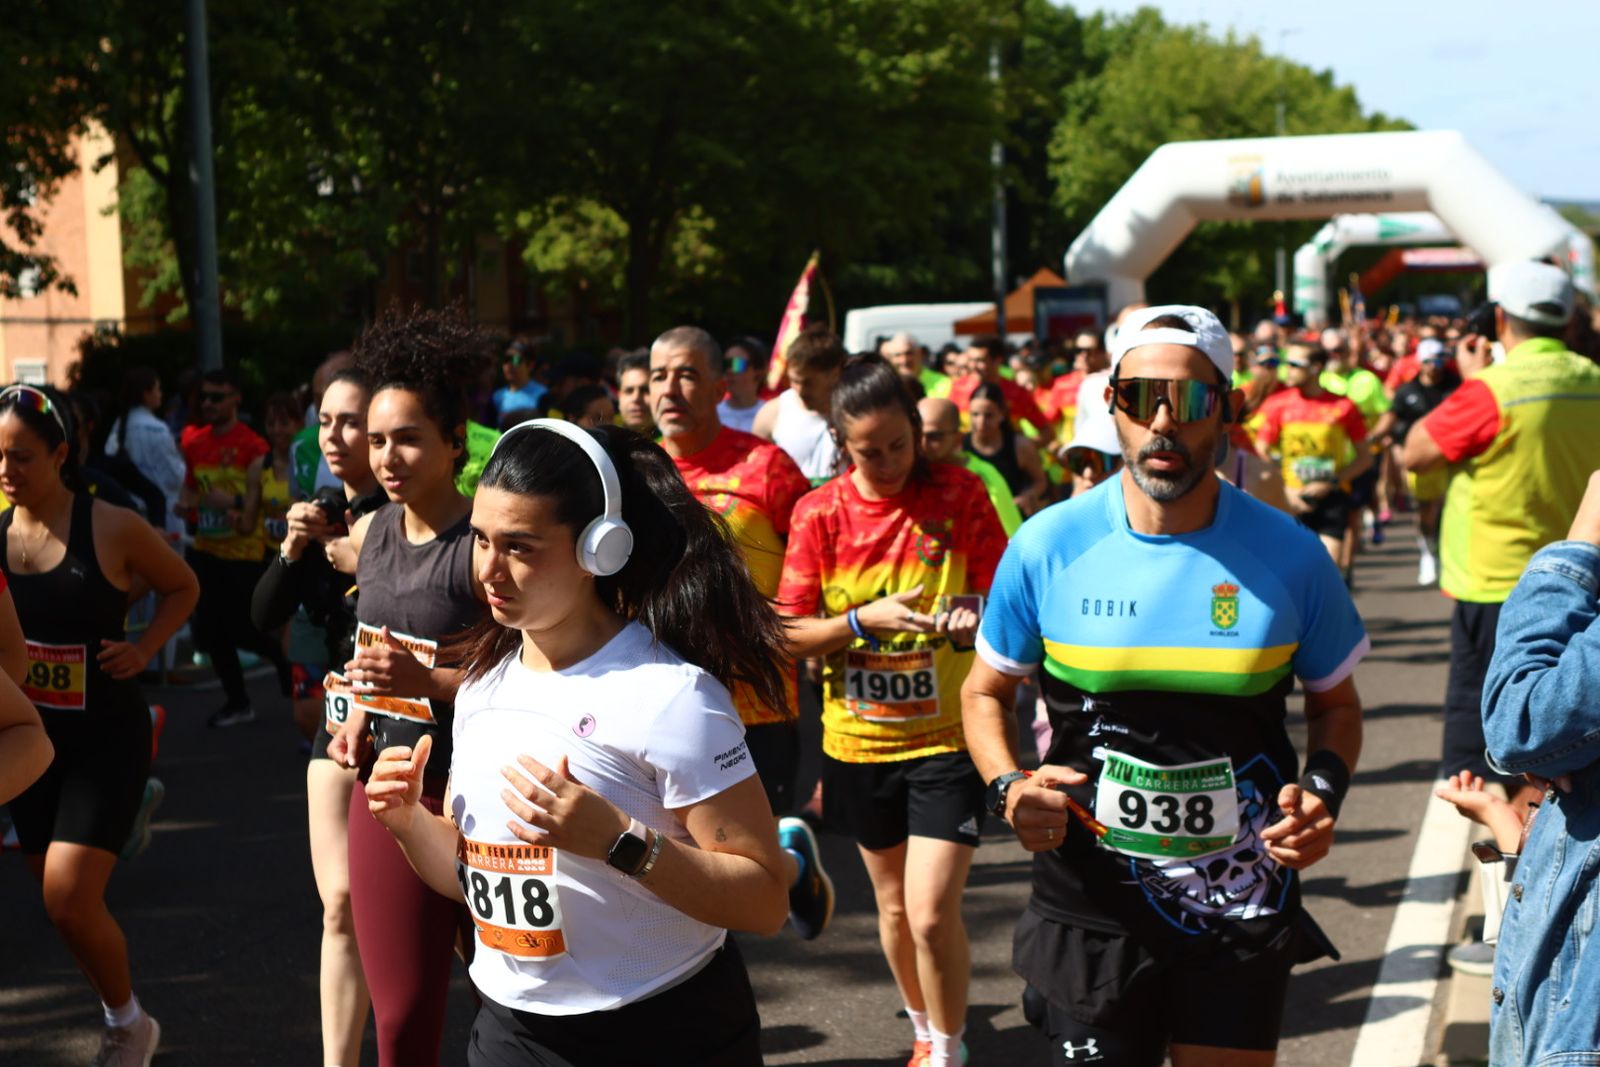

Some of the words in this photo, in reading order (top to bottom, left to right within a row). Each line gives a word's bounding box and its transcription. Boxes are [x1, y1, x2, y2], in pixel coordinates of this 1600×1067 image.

[1081, 598, 1137, 617] GOBIK
[25, 661, 71, 691] 98
[849, 670, 934, 700] 1908
[1106, 756, 1134, 783] XIV
[1135, 775, 1199, 791] CARRERA
[1118, 789, 1215, 836] 938
[487, 846, 549, 859] FERNANDO
